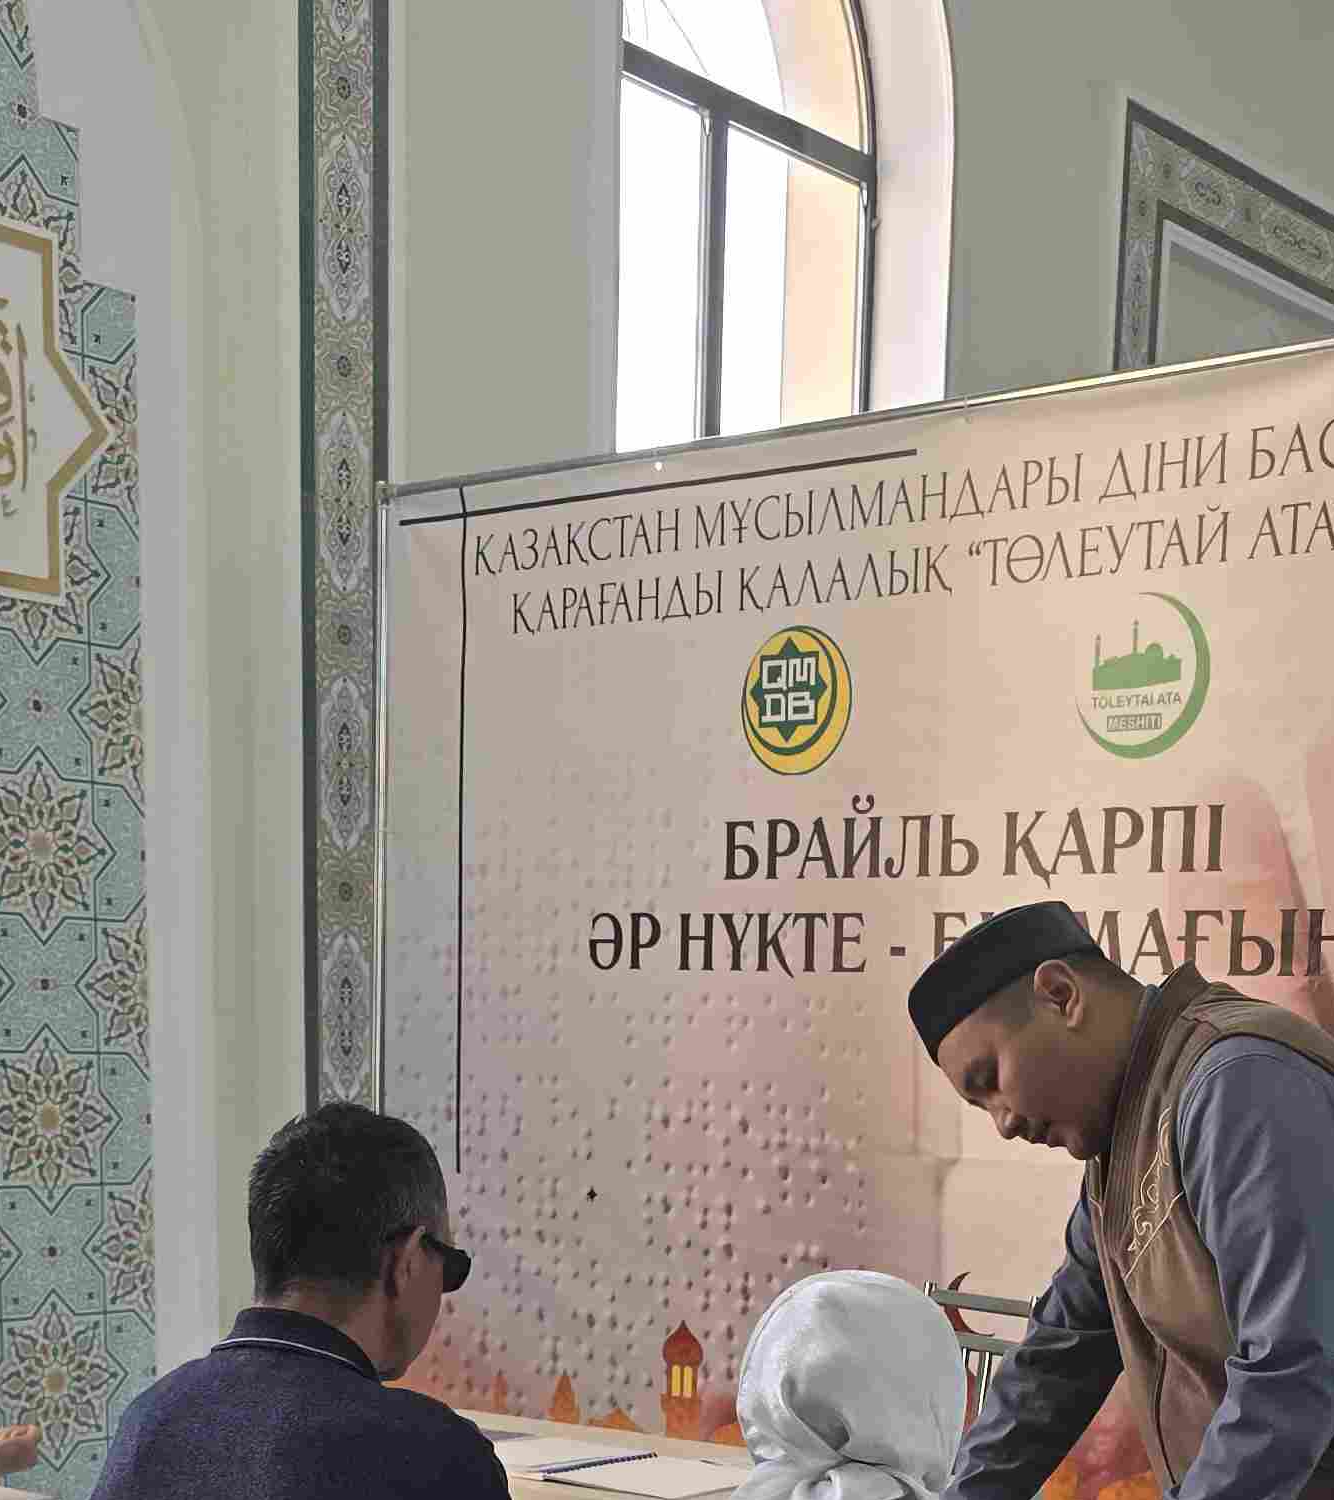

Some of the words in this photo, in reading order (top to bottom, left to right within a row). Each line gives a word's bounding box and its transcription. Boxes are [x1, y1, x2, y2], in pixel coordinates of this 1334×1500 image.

[474, 508, 680, 576] ҚАЗАҚСТАН
[695, 452, 1084, 550] МҰСЫЛМАНДАРЫ
[1099, 432, 1228, 504] ДІНИ
[512, 569, 723, 635] ҚАРАҒАНДЫ
[739, 543, 953, 613] ҚАЛАЛЫҚ
[968, 504, 1229, 587] “ТӨЛЕУТАЙ
[724, 795, 979, 881] БРАЙЛЬ
[1003, 804, 1226, 889] ҚАРПІ
[589, 912, 661, 970] ӘР
